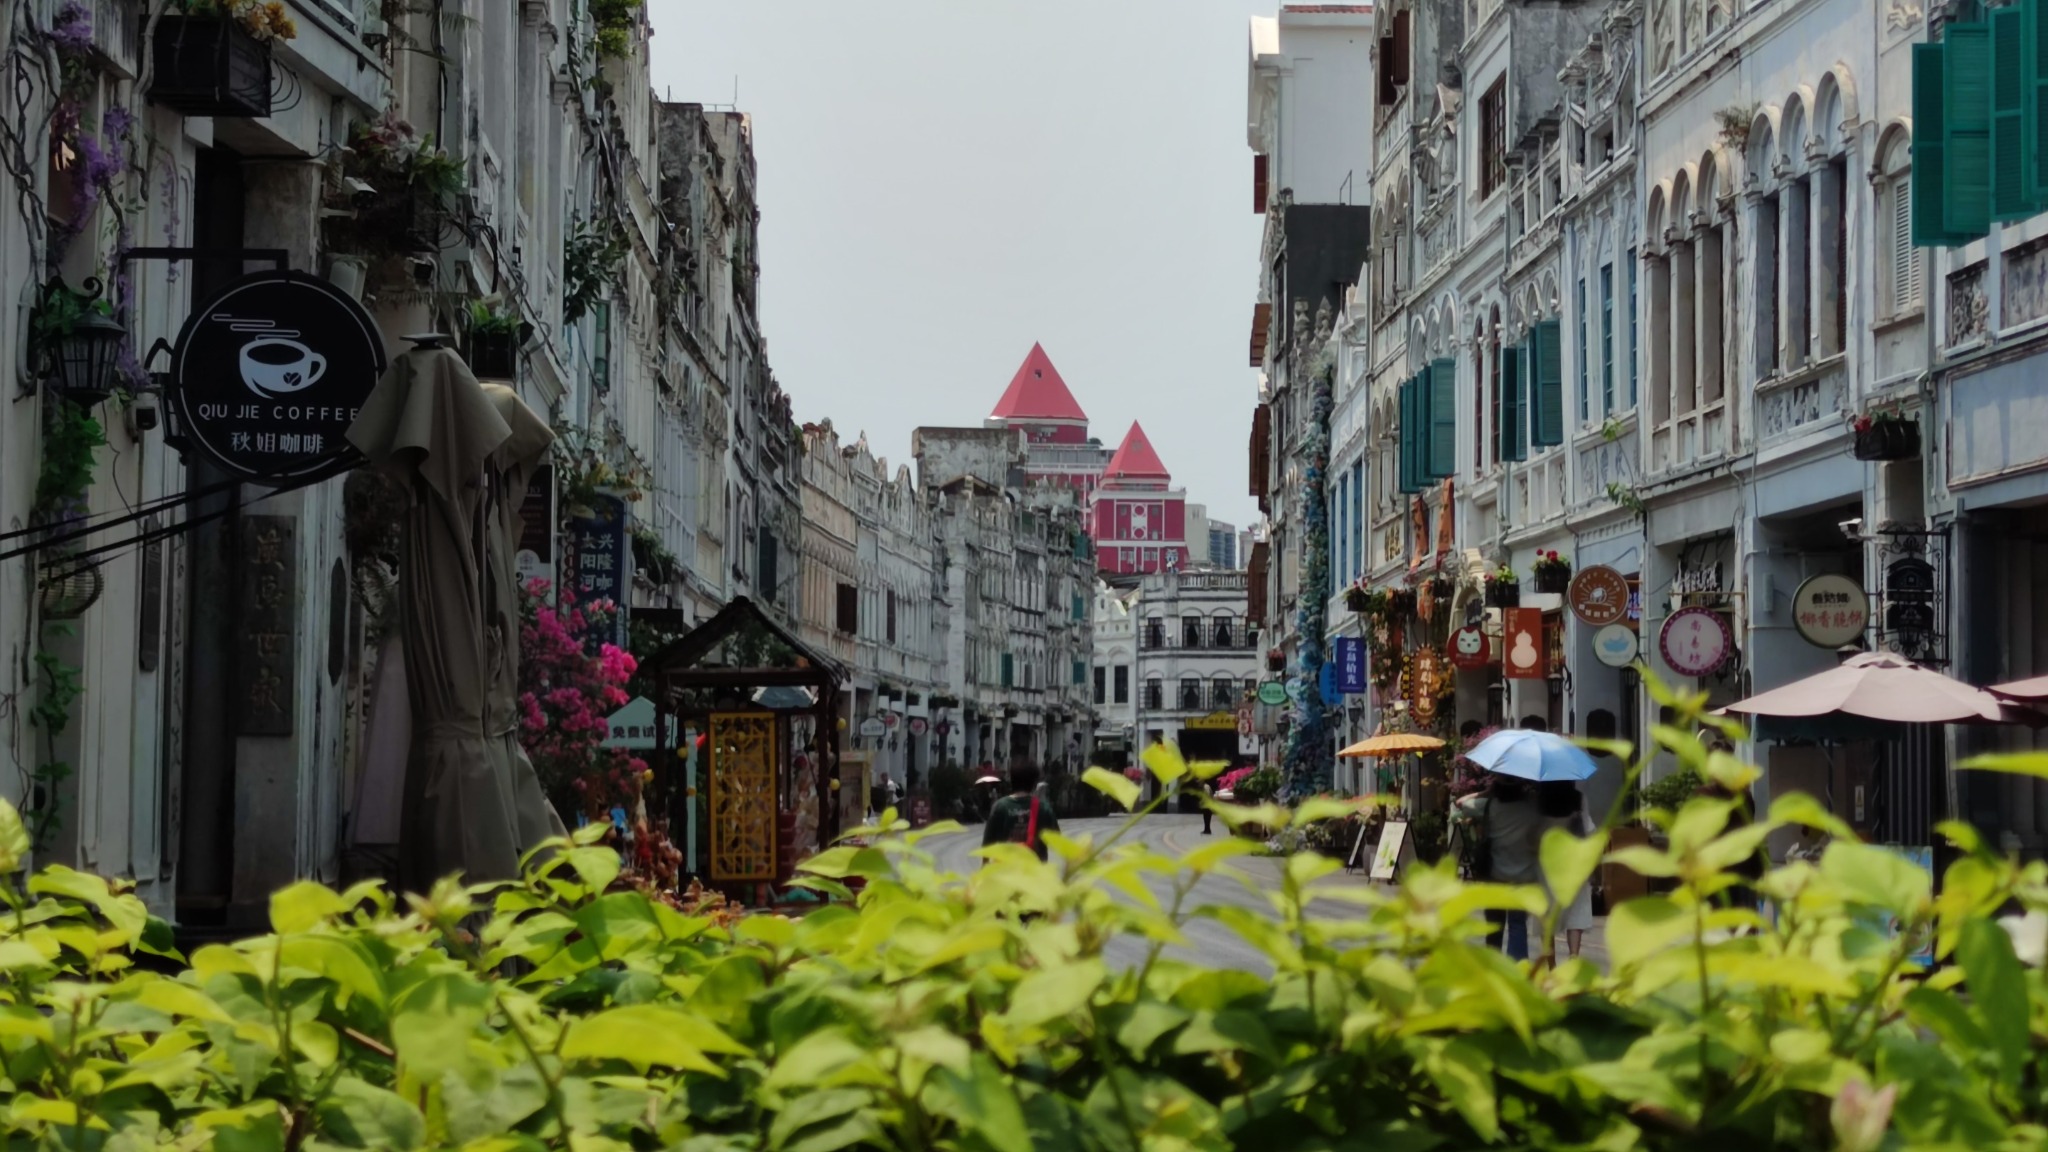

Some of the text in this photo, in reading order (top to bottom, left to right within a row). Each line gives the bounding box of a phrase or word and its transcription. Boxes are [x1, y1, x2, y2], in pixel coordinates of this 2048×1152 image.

[198, 403, 360, 421] QIU JIE COFFEE
[230, 431, 325, 454] 秋姐咖啡
